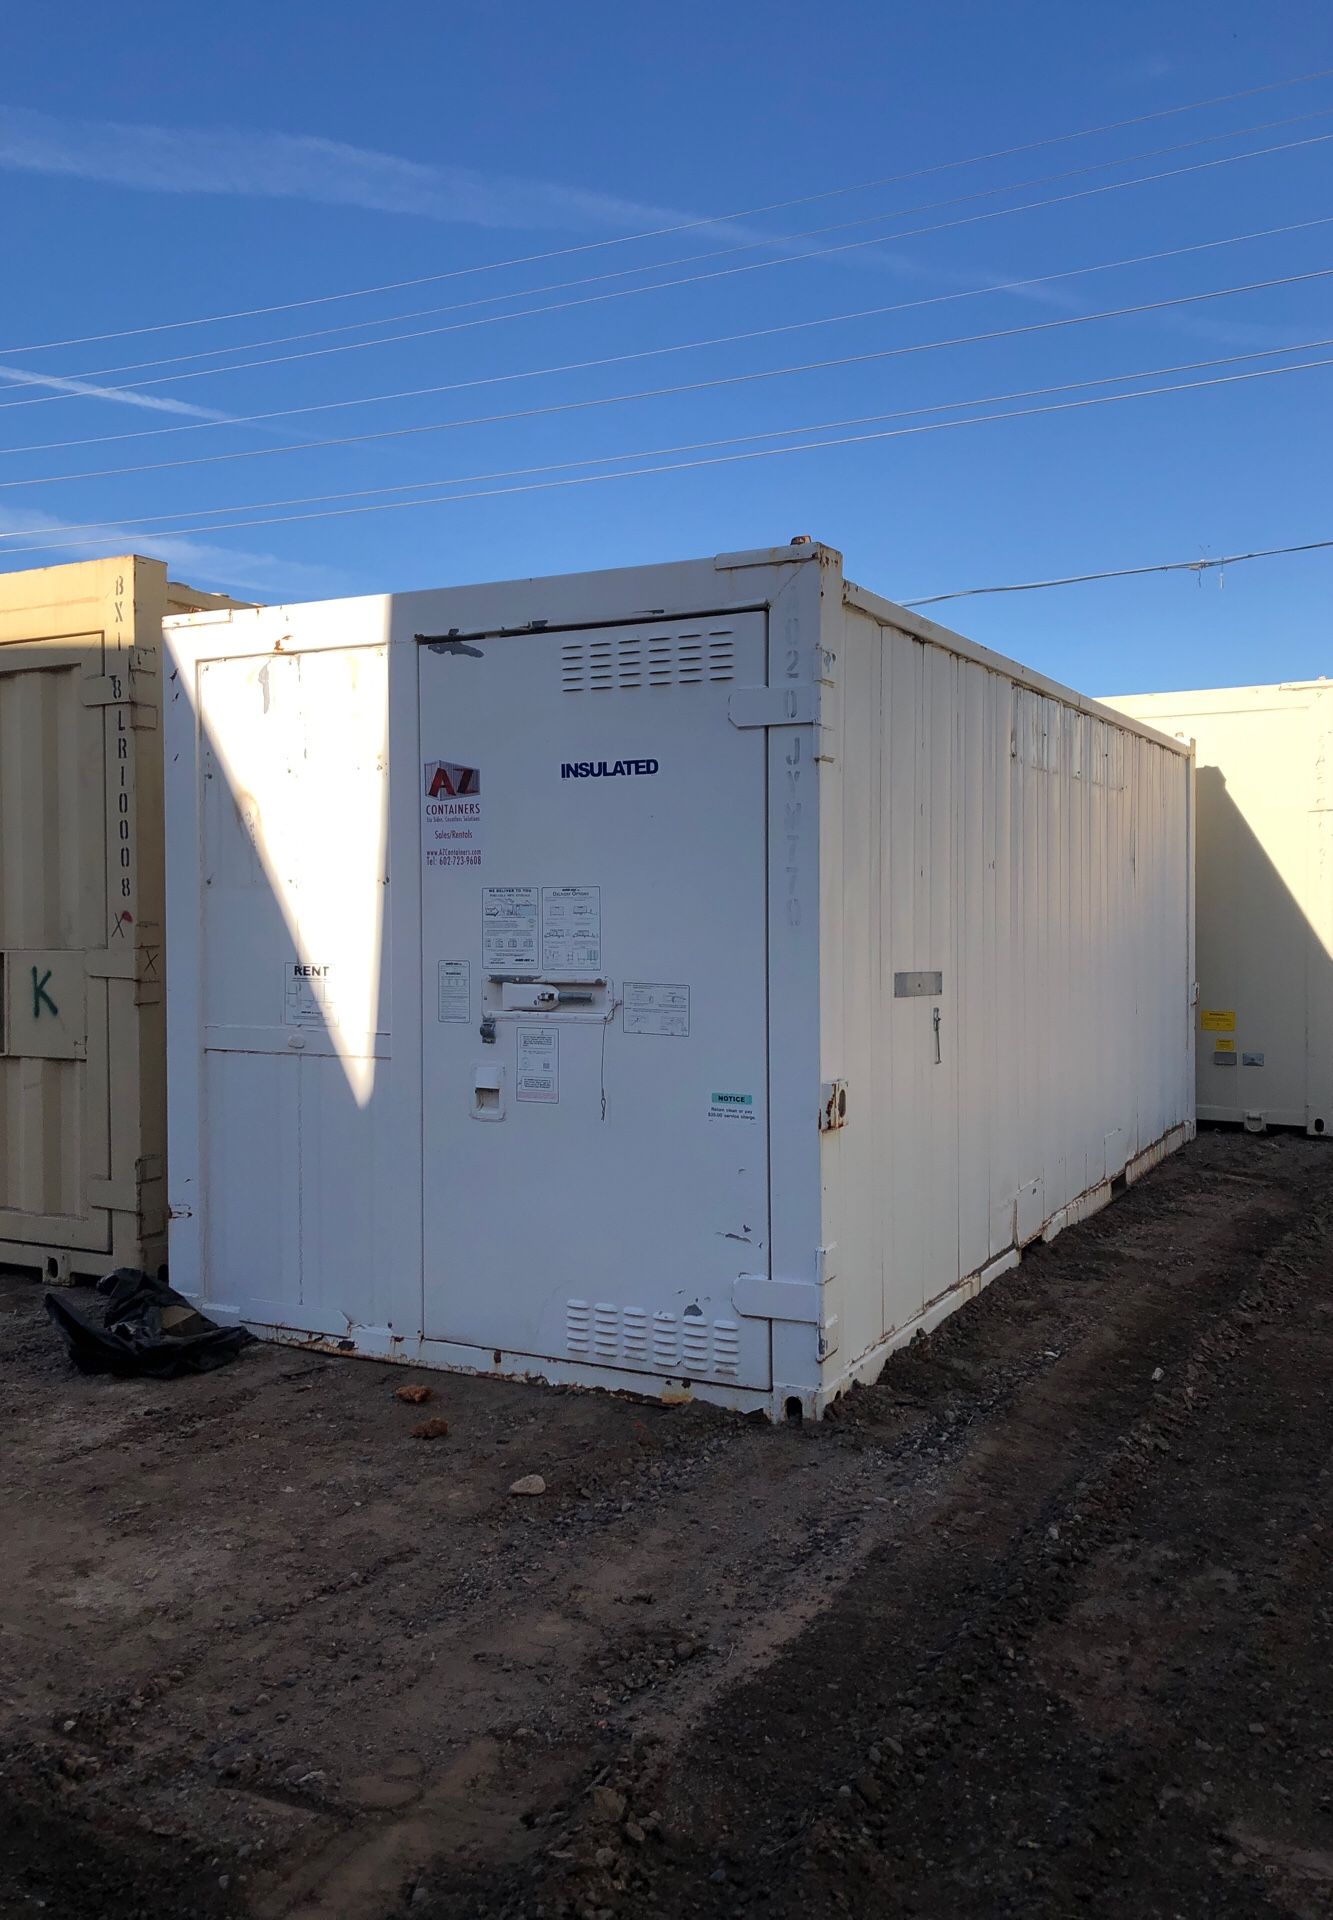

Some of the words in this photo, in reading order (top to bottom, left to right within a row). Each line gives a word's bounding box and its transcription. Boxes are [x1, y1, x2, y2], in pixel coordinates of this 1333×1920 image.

[561, 758, 659, 779] INSULATED
[428, 768, 479, 796] AZ
[426, 804, 480, 815] CONTAINERS
[435, 829, 473, 839] Sales/Rentals
[427, 848, 481, 856] www.AZContainers.com
[439, 855, 482, 866] 602-723-9608
[294, 965, 329, 976] RENT
[31, 964, 59, 1019] K
